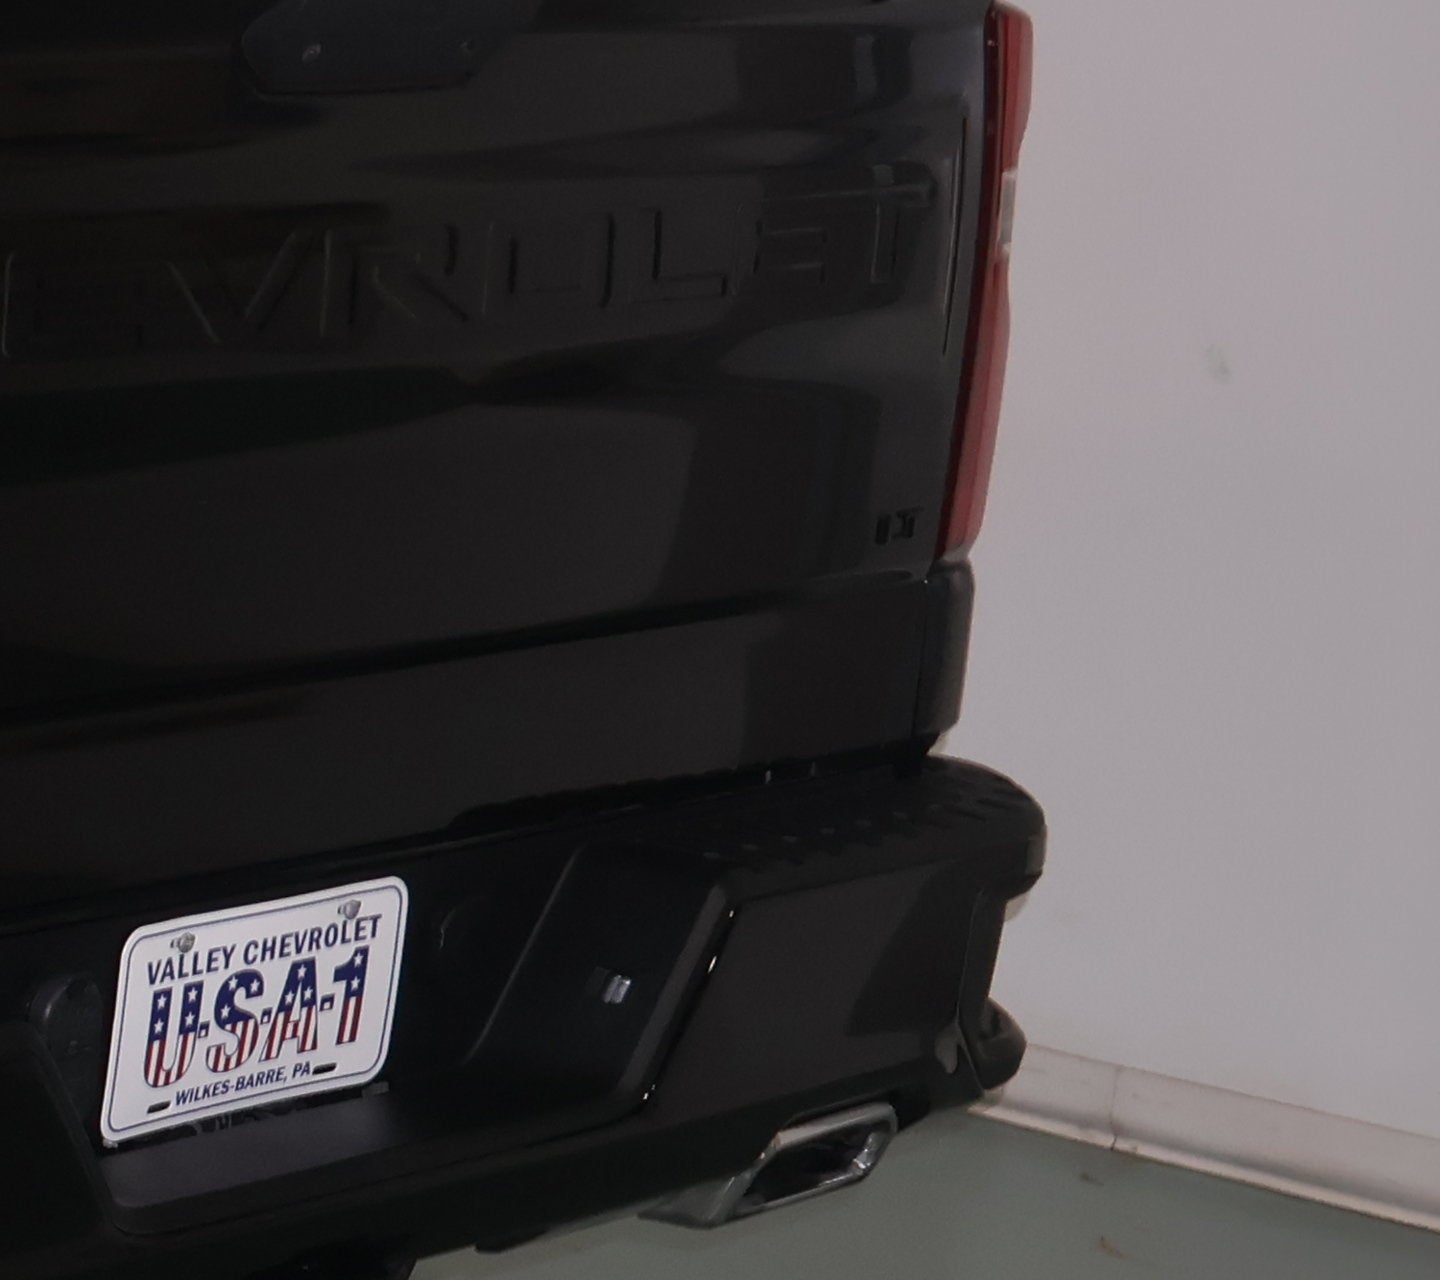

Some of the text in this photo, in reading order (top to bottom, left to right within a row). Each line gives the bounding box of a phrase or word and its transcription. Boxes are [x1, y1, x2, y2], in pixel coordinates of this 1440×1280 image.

[147, 914, 382, 986] VALLEY CHEVROLET
[175, 1061, 311, 1107] WILKES-BARRE, PA
